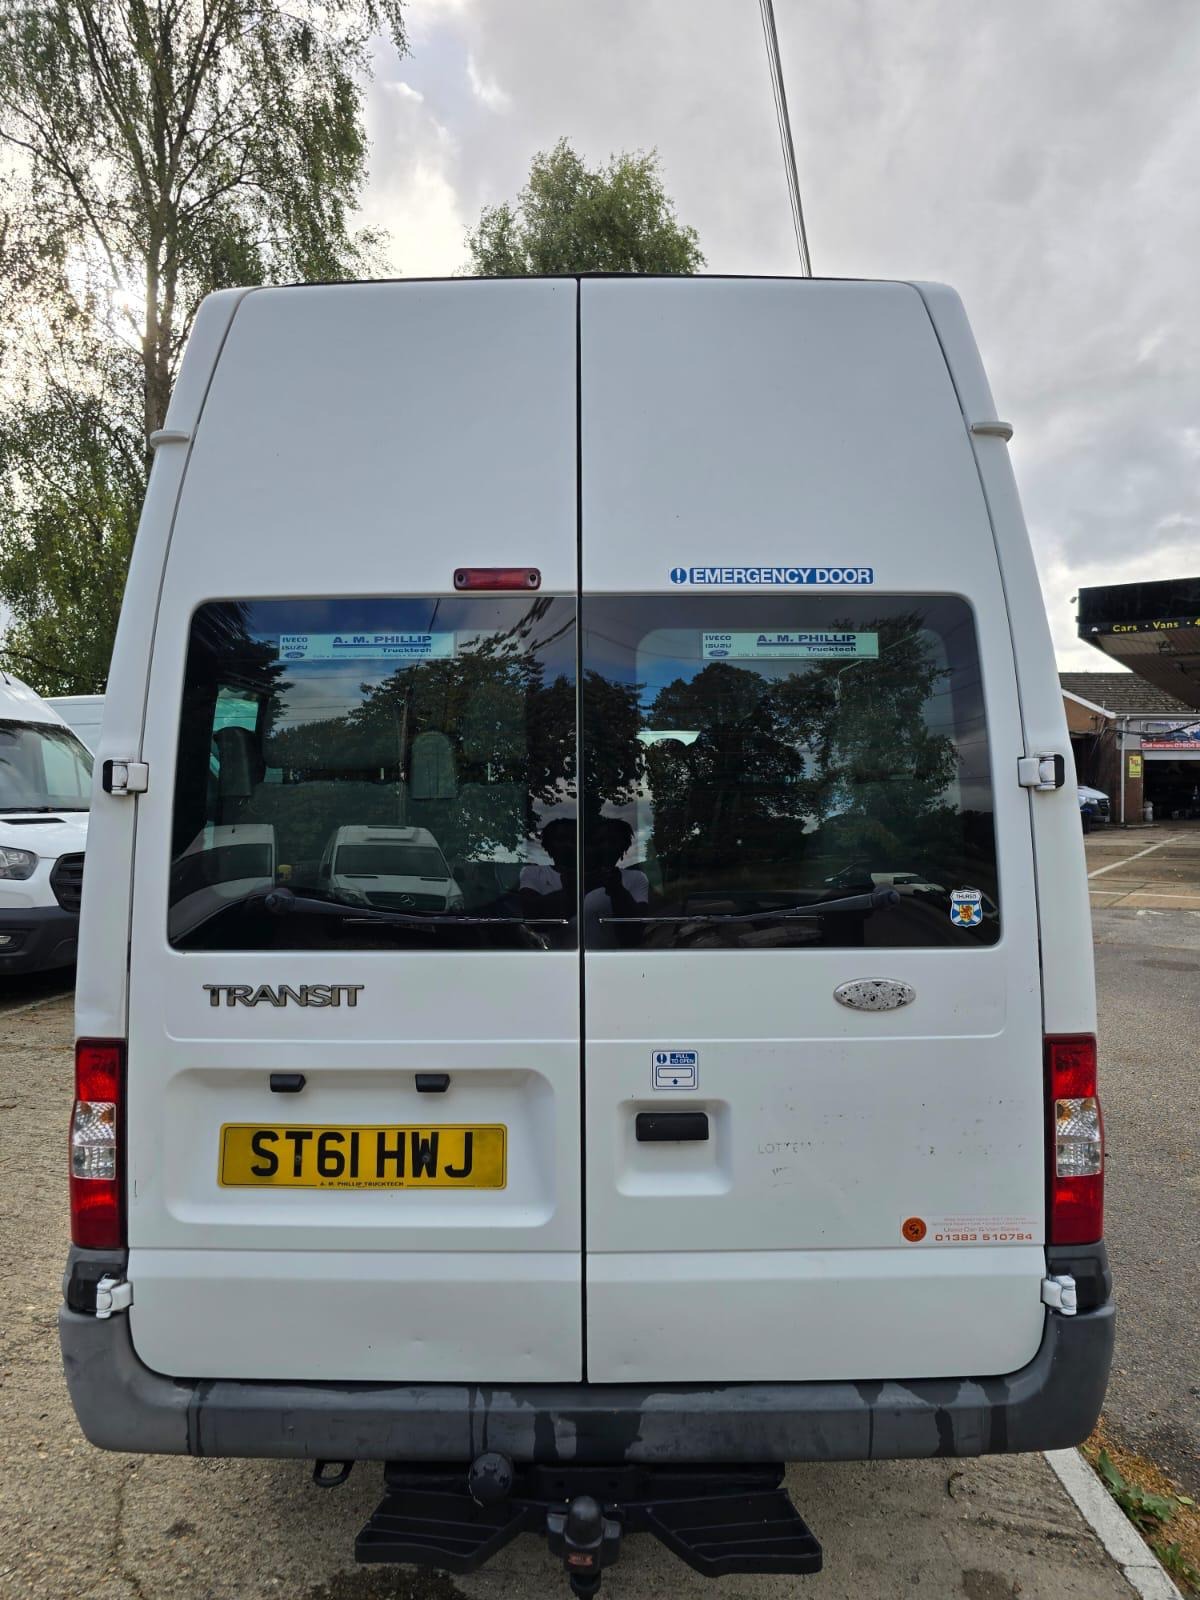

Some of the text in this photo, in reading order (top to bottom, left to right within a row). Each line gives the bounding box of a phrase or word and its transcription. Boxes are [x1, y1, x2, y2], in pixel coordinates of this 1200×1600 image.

[693, 569, 870, 584] EMERGENCY DOOR
[1112, 624, 1137, 632] Cars
[1153, 621, 1179, 629] Vans
[333, 635, 432, 644] A. M. PHILLIP
[798, 634, 856, 642] PHILLIP
[202, 984, 365, 1007] TRANSIT
[250, 1130, 474, 1178] ST61 HWJ
[935, 1233, 1032, 1241] 01383 510784
